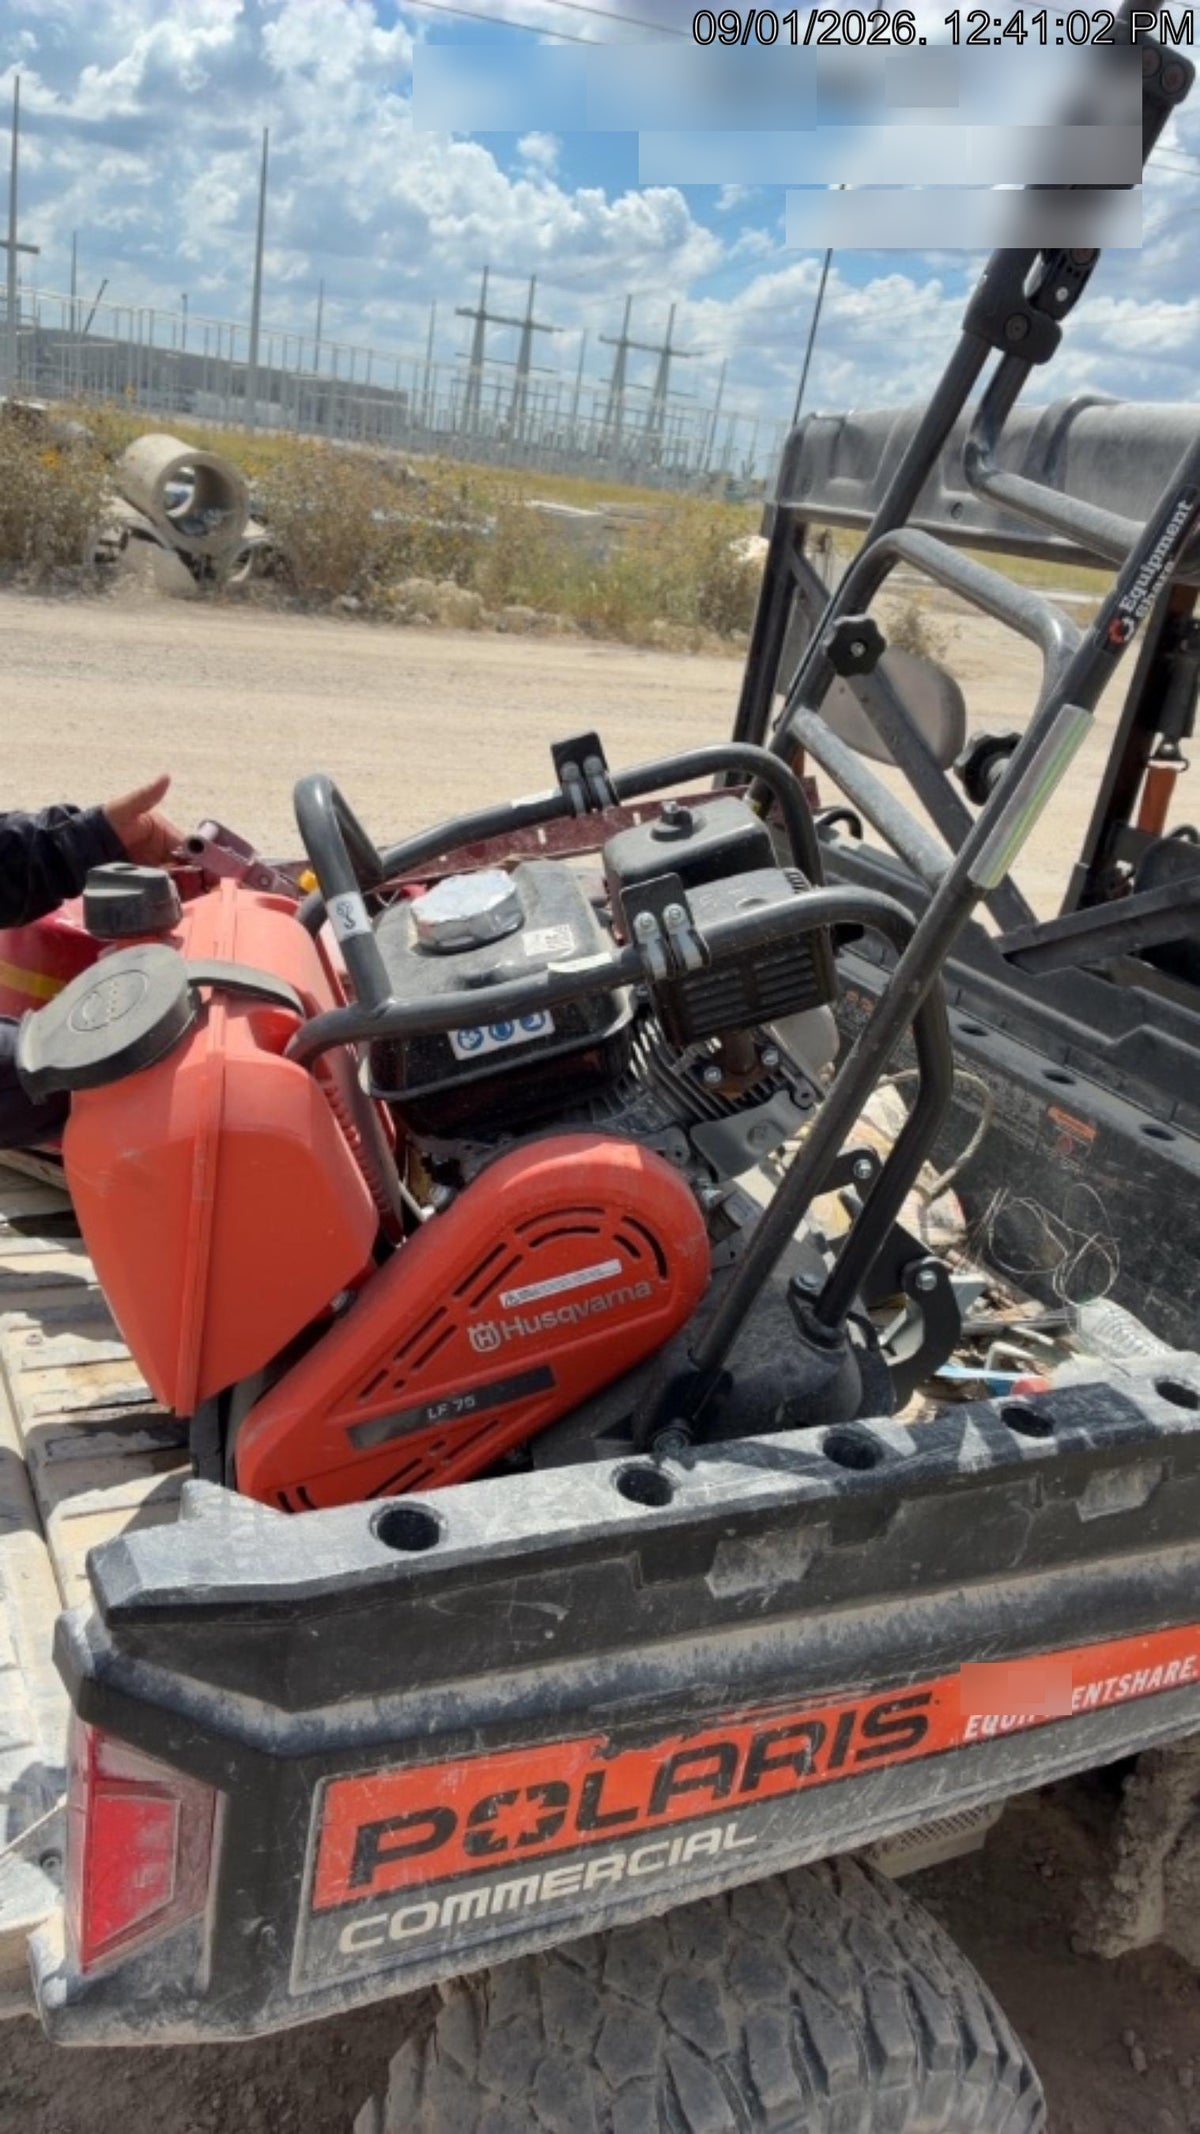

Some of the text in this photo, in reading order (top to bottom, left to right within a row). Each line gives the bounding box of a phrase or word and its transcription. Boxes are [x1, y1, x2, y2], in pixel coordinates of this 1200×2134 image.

[1118, 500, 1194, 613] Equipment
[502, 1280, 653, 1341] Husqvarna
[427, 1402, 448, 1419] LF
[348, 1691, 935, 1889] POLARIS
[339, 1821, 759, 1955] COMMERCIAL
